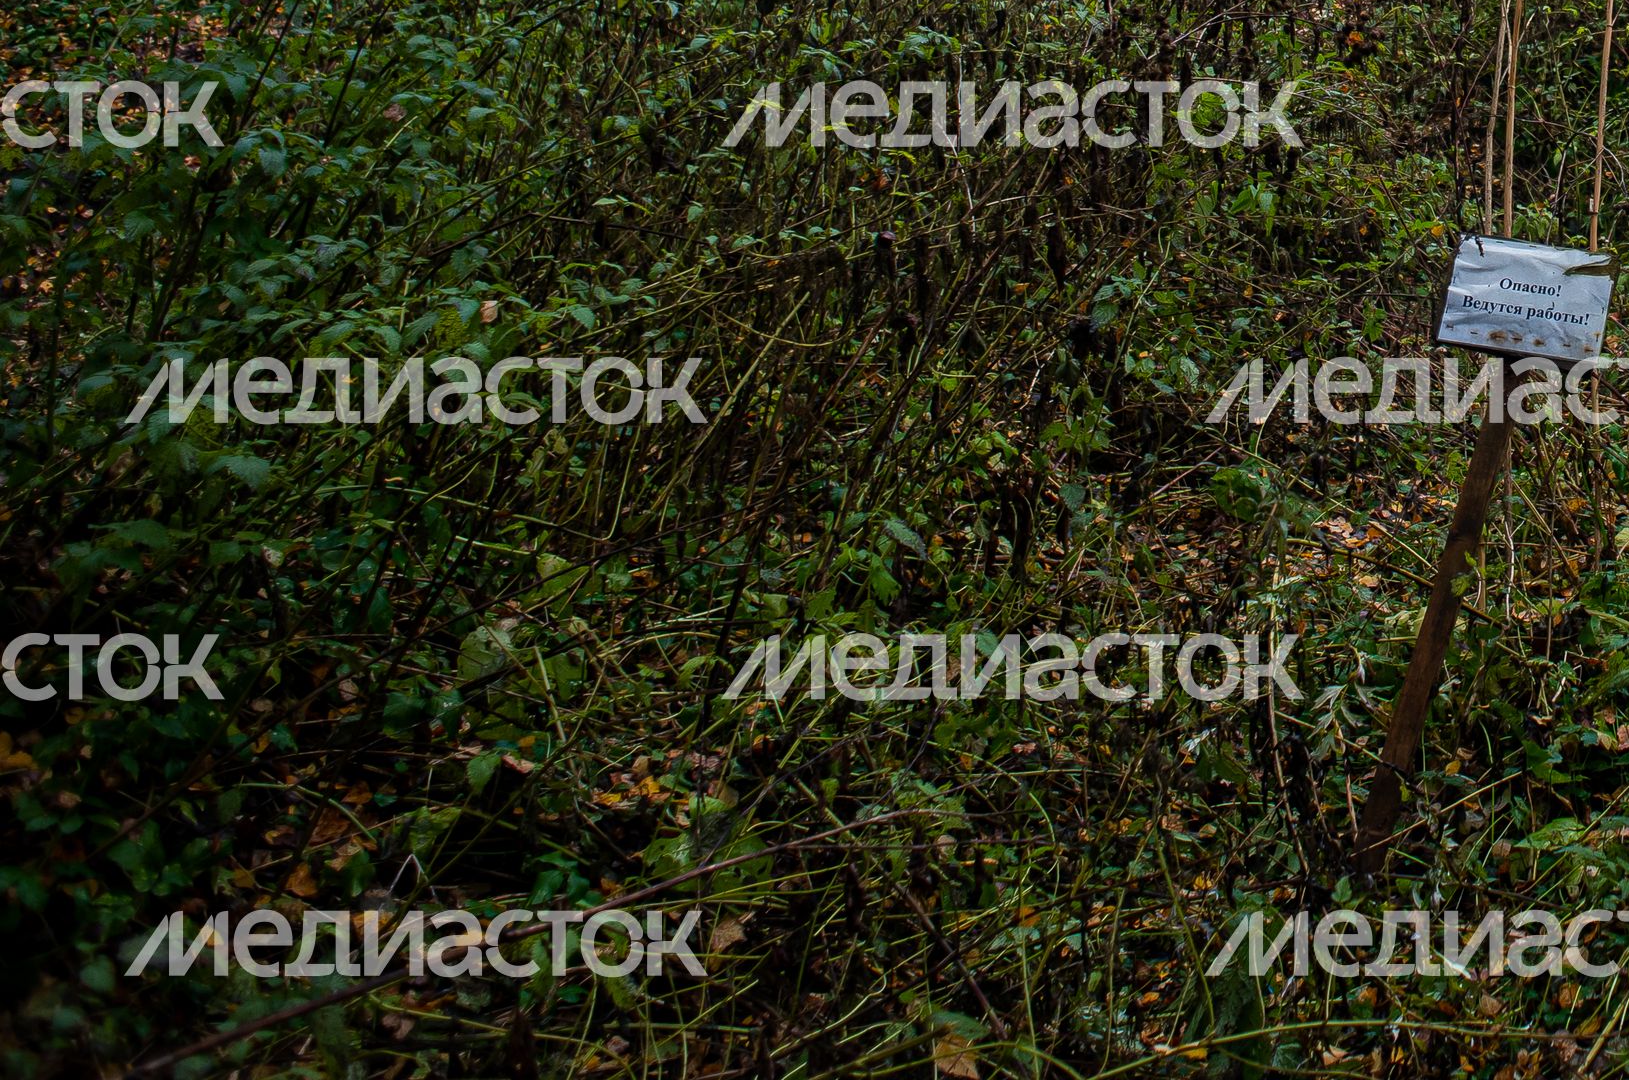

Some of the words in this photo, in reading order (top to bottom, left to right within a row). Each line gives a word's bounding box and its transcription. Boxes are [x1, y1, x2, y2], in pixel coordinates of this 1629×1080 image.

[1499, 277, 1562, 297] Опасно!
[1462, 295, 1522, 316] Ведутся
[1526, 301, 1590, 326] работы!
